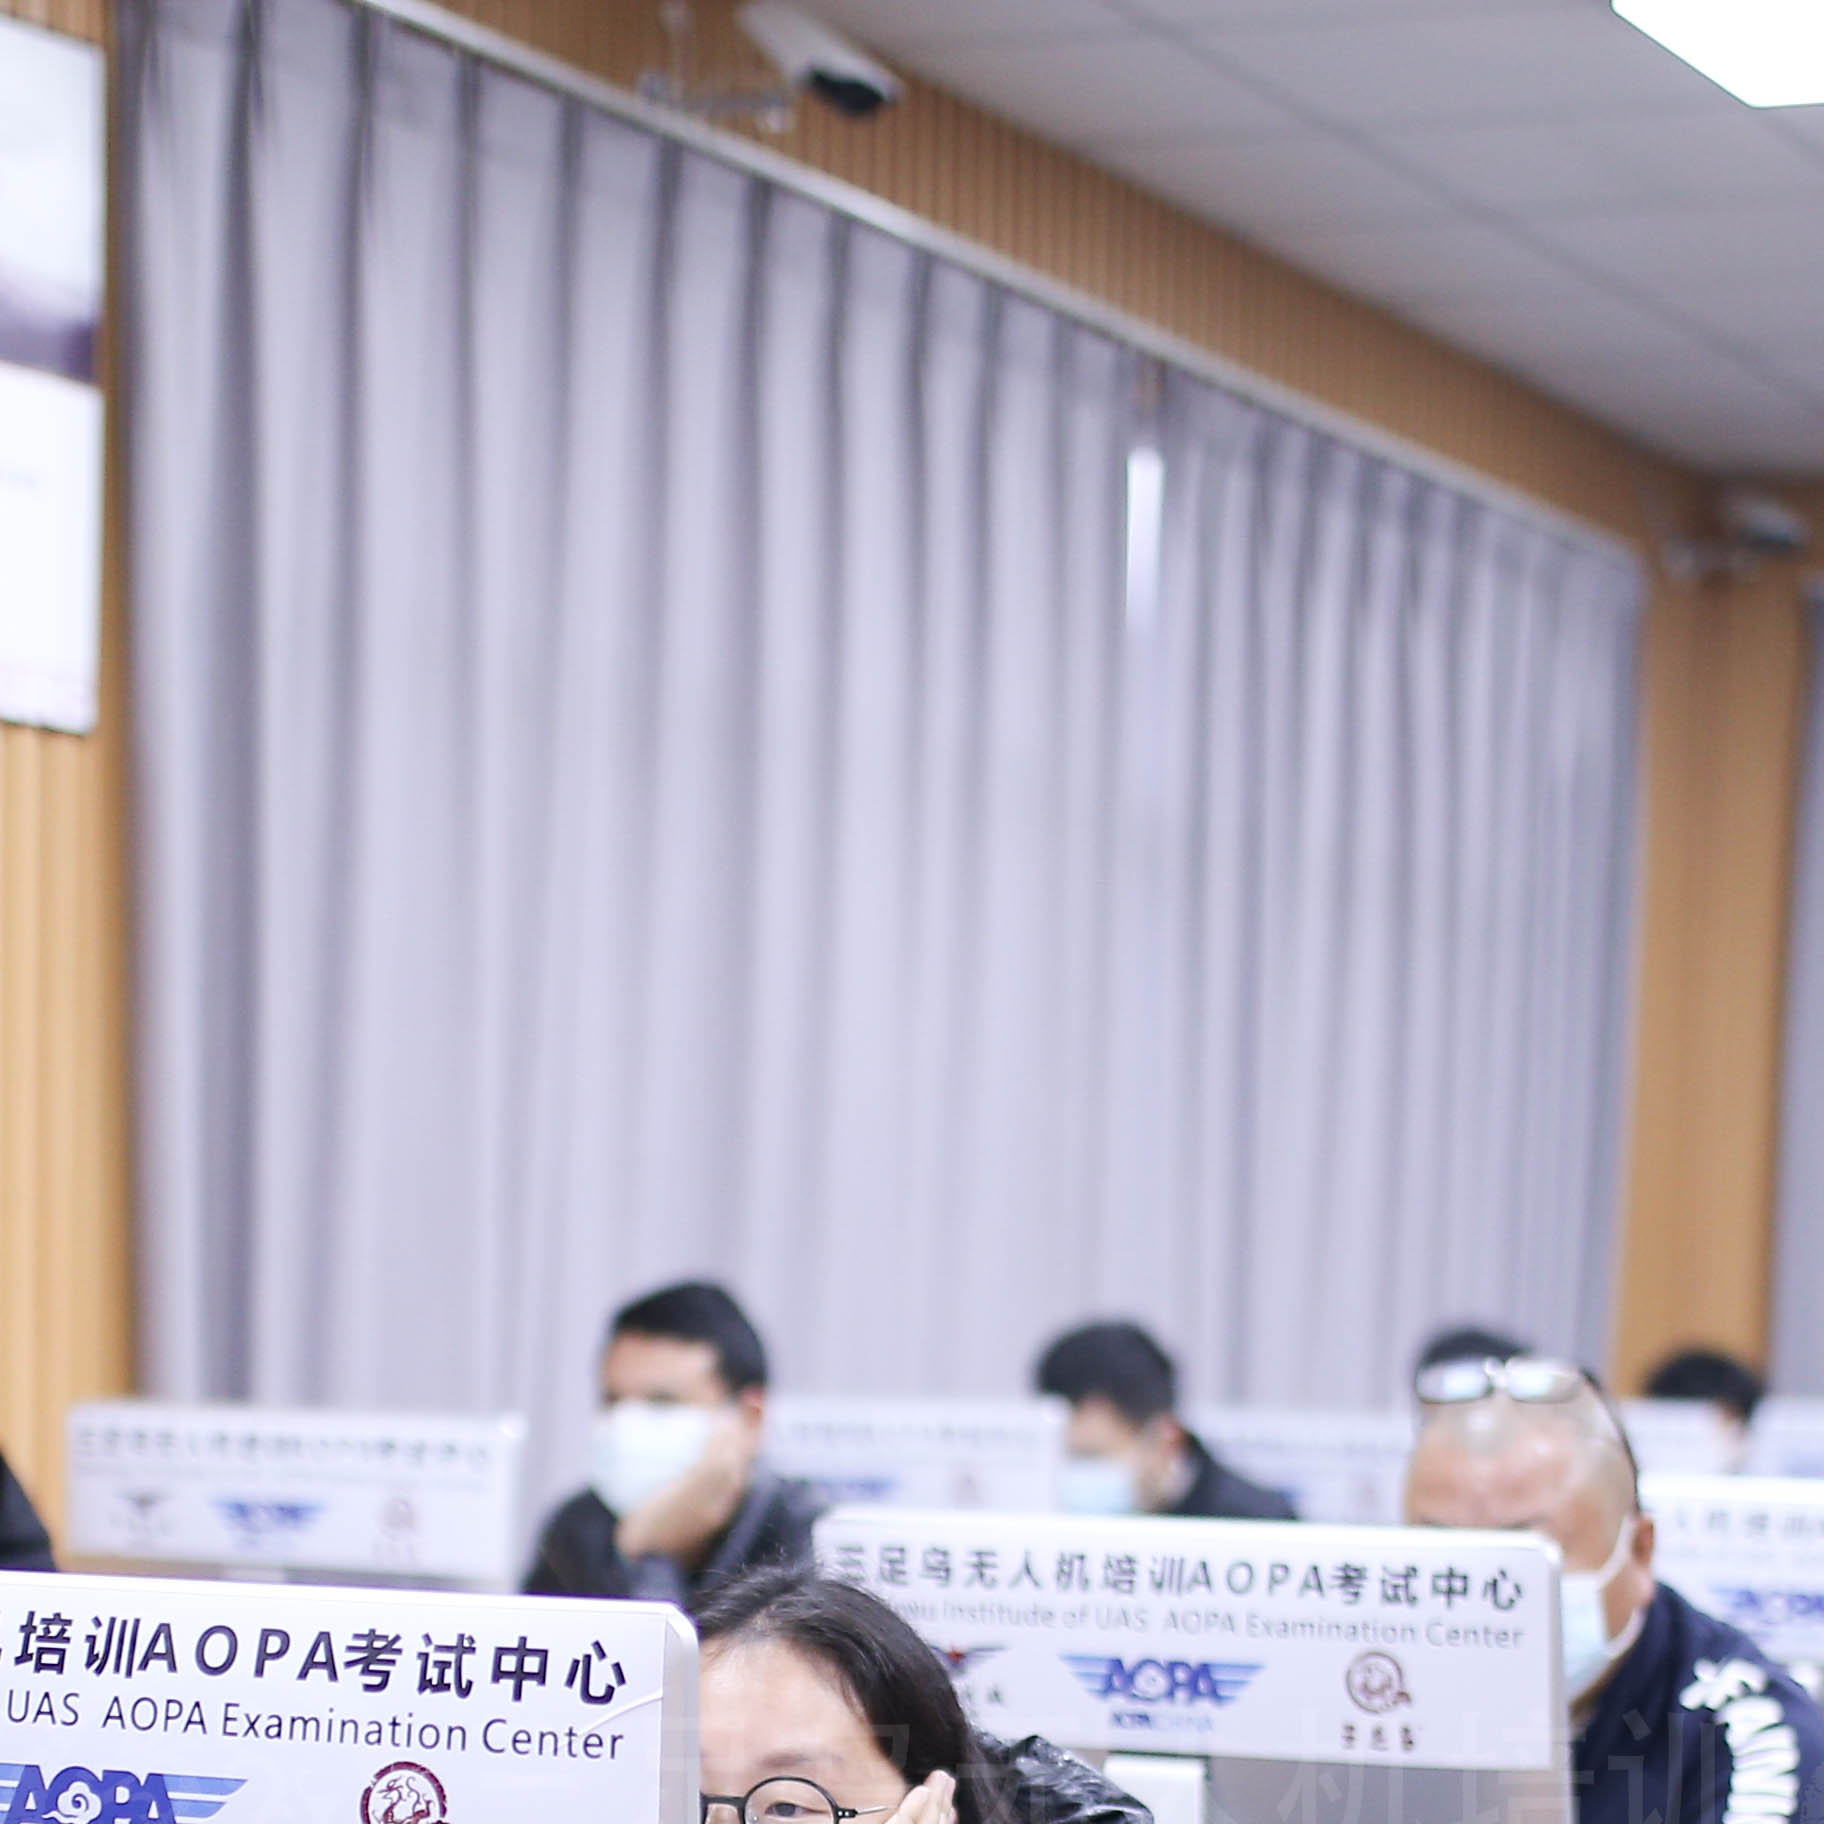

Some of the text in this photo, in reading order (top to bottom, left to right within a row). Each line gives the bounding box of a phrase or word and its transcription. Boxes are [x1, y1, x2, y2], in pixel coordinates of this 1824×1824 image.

[834, 1545, 1524, 1612] 三足乌无人机培训AOPA考试中心
[1245, 1613, 1417, 1645] Examination
[1425, 1620, 1526, 1650] Center
[6, 1688, 81, 1728] UAS
[102, 1695, 208, 1736] AOPA
[222, 1702, 467, 1752] Examination
[481, 1718, 625, 1762] Center
